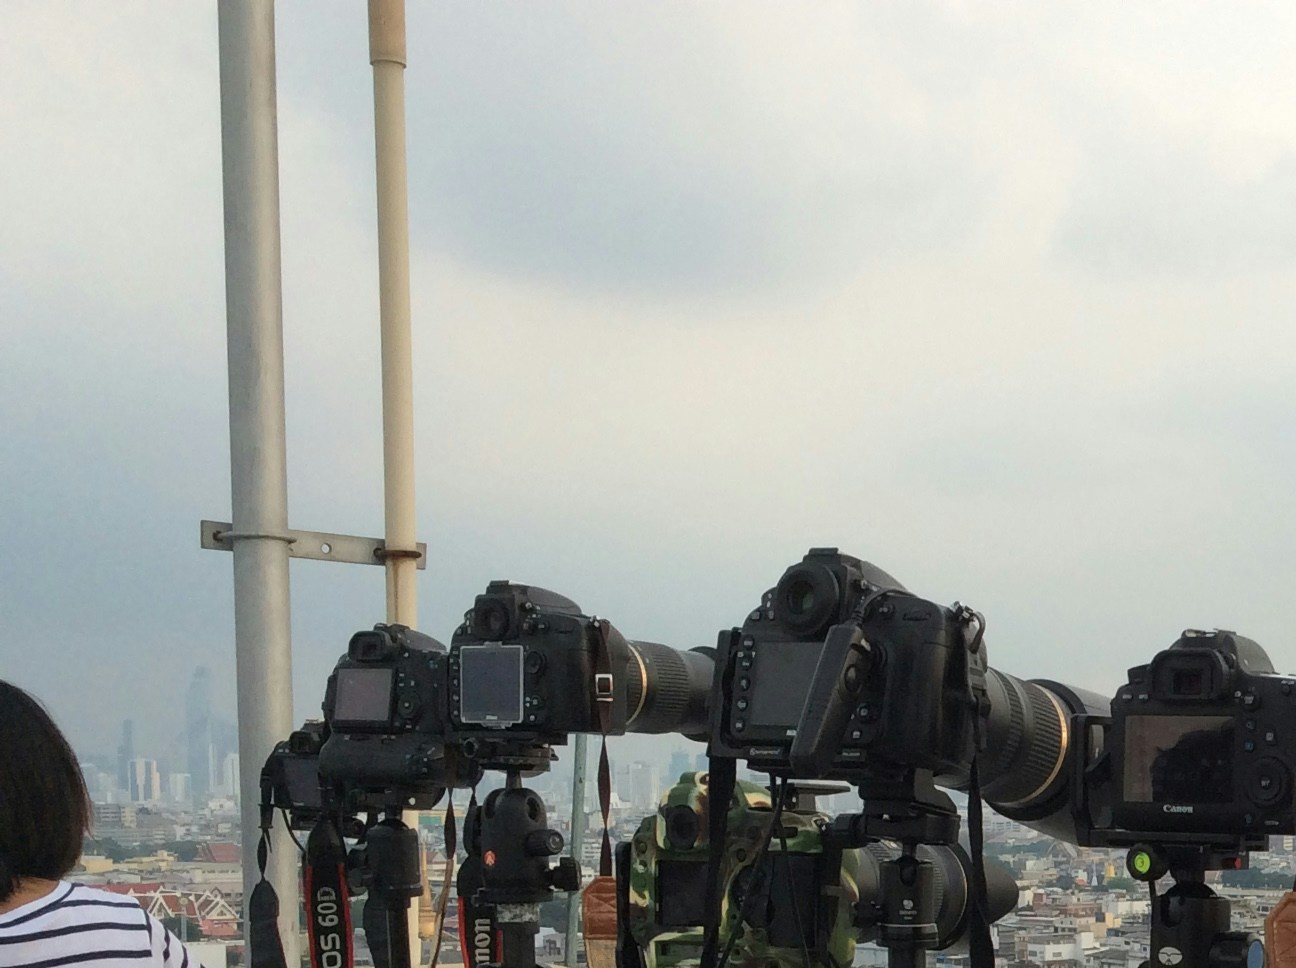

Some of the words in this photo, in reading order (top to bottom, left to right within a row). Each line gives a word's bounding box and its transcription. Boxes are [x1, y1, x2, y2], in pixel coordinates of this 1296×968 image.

[1162, 804, 1194, 814] Canon
[317, 886, 339, 927] 60D
[474, 918, 491, 964] non
